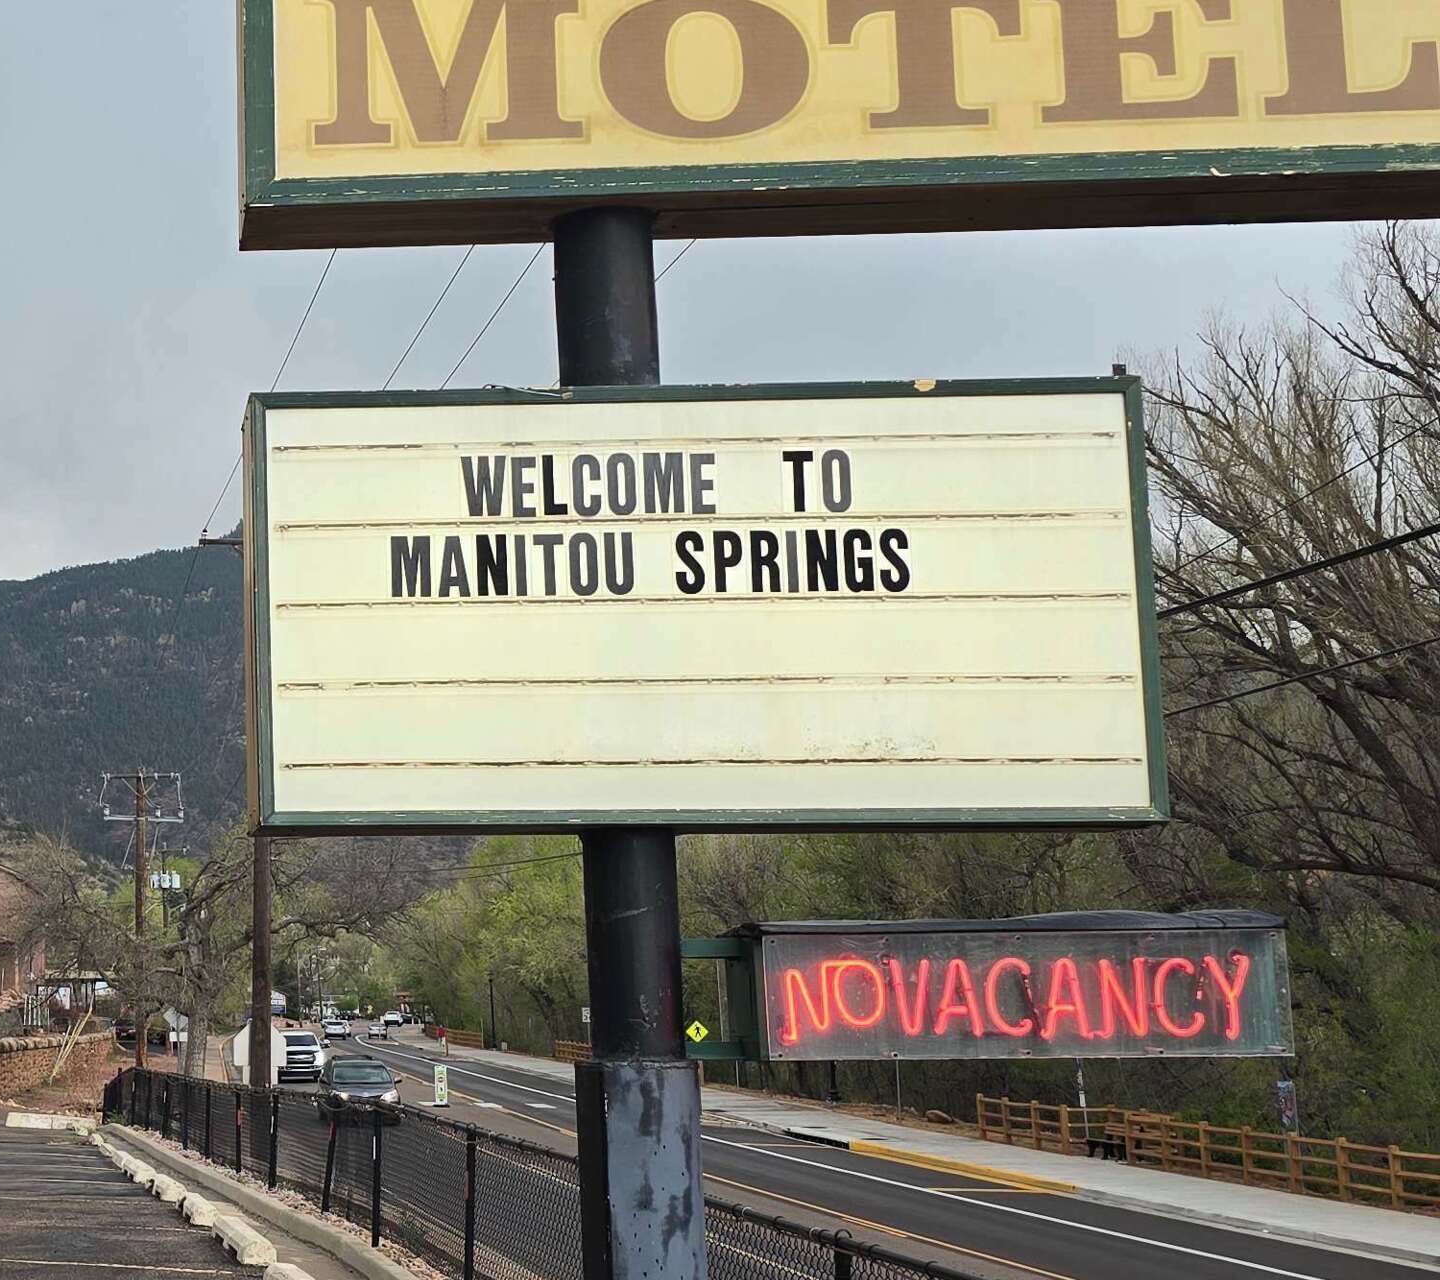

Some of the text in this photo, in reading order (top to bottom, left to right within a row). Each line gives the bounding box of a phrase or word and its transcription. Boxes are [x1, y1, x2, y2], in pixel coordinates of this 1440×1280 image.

[460, 448, 852, 518] WELCOME TO
[389, 527, 911, 598] MANITOU SPRINGS
